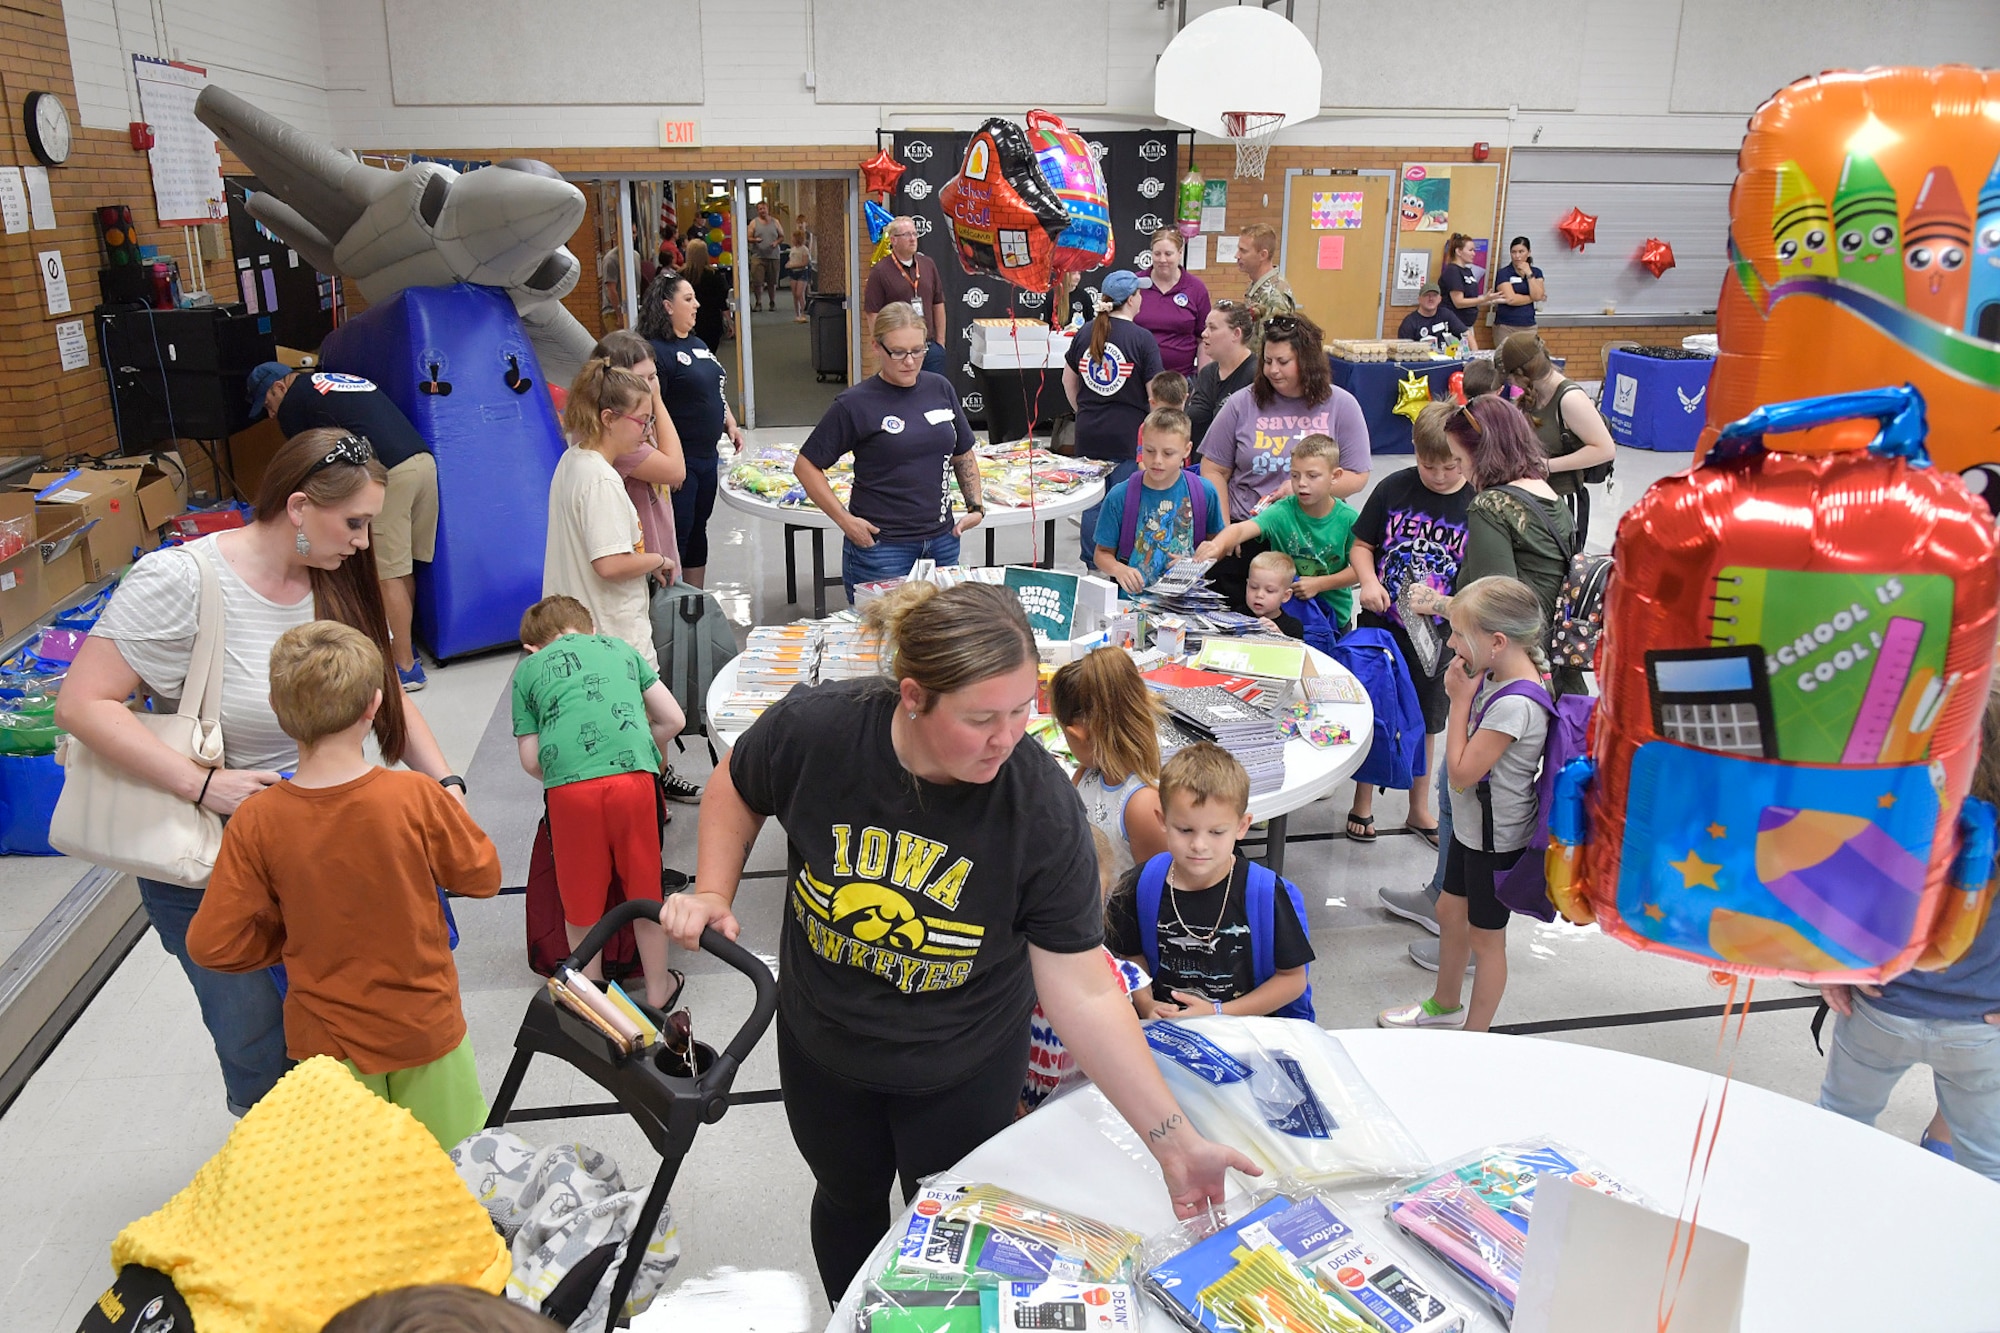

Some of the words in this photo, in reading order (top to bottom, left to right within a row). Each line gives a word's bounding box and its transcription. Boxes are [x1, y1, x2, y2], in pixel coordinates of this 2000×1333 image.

[666, 122, 694, 143] EXIT
[904, 146, 933, 157] KENTS
[1139, 145, 1167, 157] KENTS
[957, 179, 992, 202] School
[955, 203, 990, 227] Cool!
[1135, 218, 1163, 230] KENTS
[1019, 293, 1046, 304] KENTS
[1086, 375, 1122, 392] HOMEFRONT
[1256, 412, 1329, 431] saved
[1253, 430, 1290, 456] by
[1252, 452, 1291, 476] gra
[1389, 509, 1466, 553] VENOM
[1019, 586, 1060, 601] EXTRA
[1024, 605, 1065, 624] PPLIES
[1765, 603, 1869, 675] SCHOOL
[1876, 577, 1904, 605] IS
[832, 824, 974, 911] IOWA
[792, 890, 974, 994] HAWKEYES
[926, 1190, 964, 1202] DEXIN
[991, 1232, 1042, 1252] Oxford
[1301, 1222, 1345, 1250] Oxford
[1327, 1246, 1363, 1270] DEXIN
[1112, 1291, 1127, 1324] DEXIN
